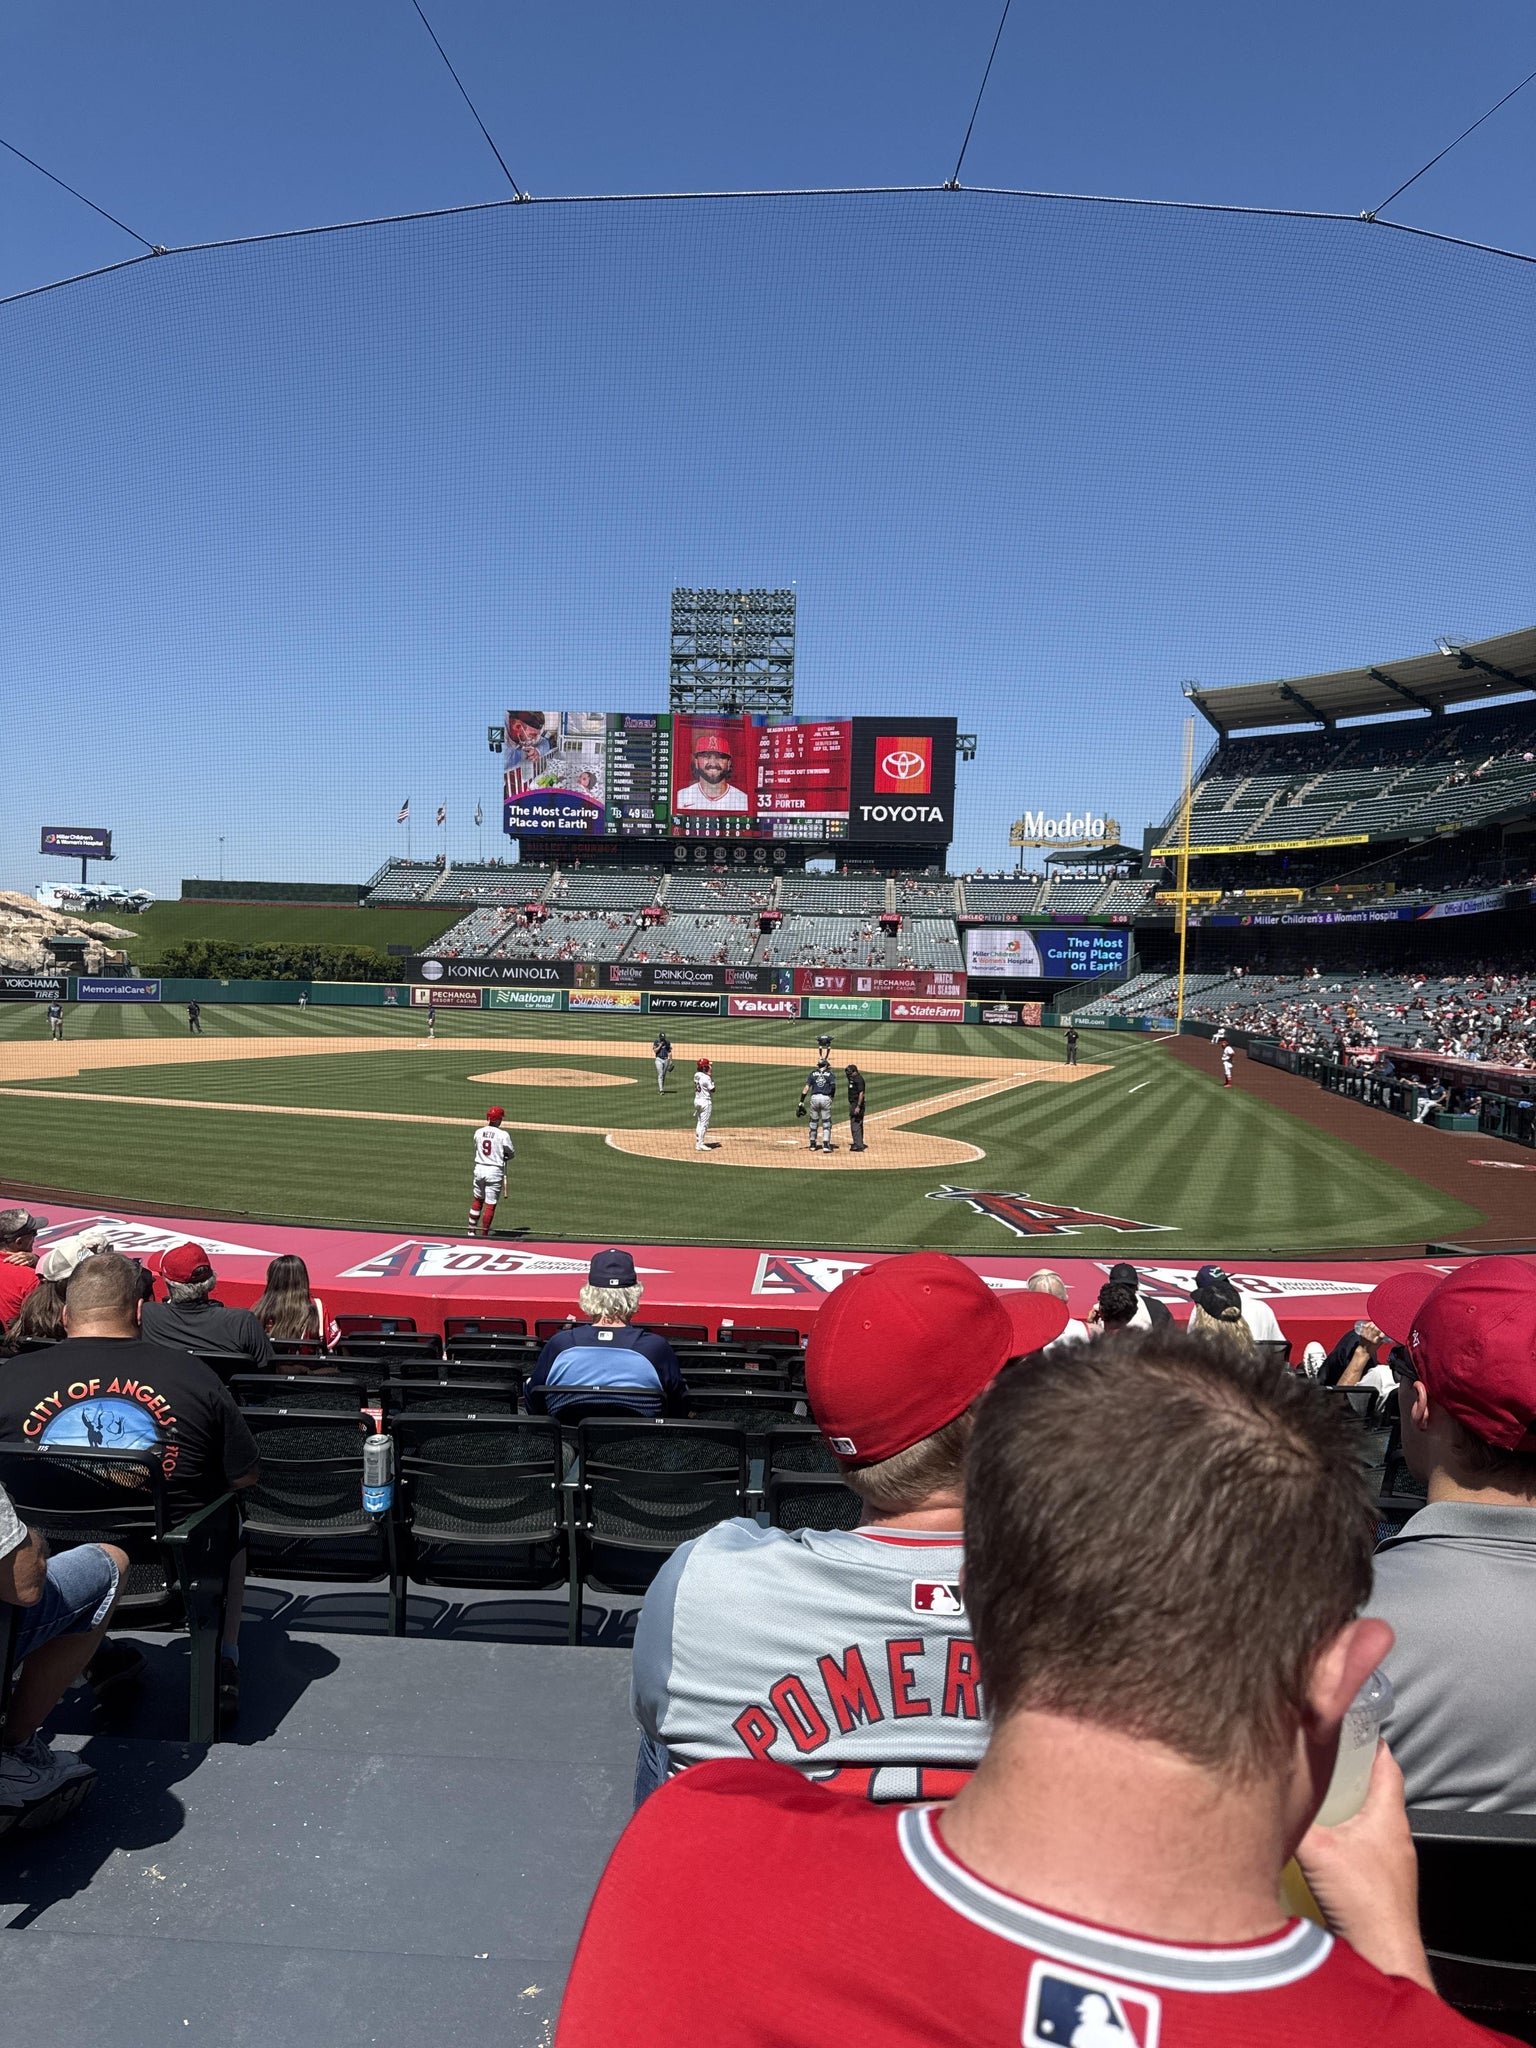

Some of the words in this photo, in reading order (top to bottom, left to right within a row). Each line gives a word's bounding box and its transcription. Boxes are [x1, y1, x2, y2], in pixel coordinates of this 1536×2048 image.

[757, 794, 772, 807] 33
[776, 800, 806, 808] PORTER
[509, 806, 530, 816] The
[532, 806, 560, 816] Most
[562, 807, 598, 819] Caring
[628, 808, 640, 818] 49
[860, 806, 944, 822] TOYOTA
[510, 818, 538, 827] Place
[558, 819, 588, 828] Earth
[1025, 811, 1104, 838] Modelo
[1445, 904, 1462, 914] Official
[1254, 916, 1280, 924] Miller
[1282, 914, 1323, 924] Children's
[1334, 913, 1366, 922] Women's
[1370, 911, 1398, 922] Hospital
[1068, 938, 1090, 947] The
[1093, 938, 1123, 948] Most
[1048, 949, 1086, 961] Caring
[1090, 950, 1122, 959] Place
[630, 968, 642, 976] One
[1090, 961, 1122, 971] Earth
[448, 966, 498, 978] KONICA
[502, 968, 559, 980] MINOLTA
[745, 971, 758, 980] One
[934, 973, 954, 984] WATCH
[5, 979, 60, 988] YOKOHAMA
[814, 976, 845, 988] BTV
[83, 985, 145, 994] MemorialCare
[926, 984, 936, 994] ALL
[938, 985, 960, 996] SEASON
[510, 992, 555, 1003] National
[574, 994, 614, 1006] Surfside
[652, 999, 677, 1007] NITTO
[679, 1000, 718, 1008] TIRE.COM
[734, 1000, 792, 1012] Yakult
[482, 1140, 491, 1156] 9
[443, 1253, 532, 1272] '05
[23, 1391, 62, 1436] CITY
[68, 1378, 100, 1400] OF
[106, 1376, 177, 1426] ANGELS
